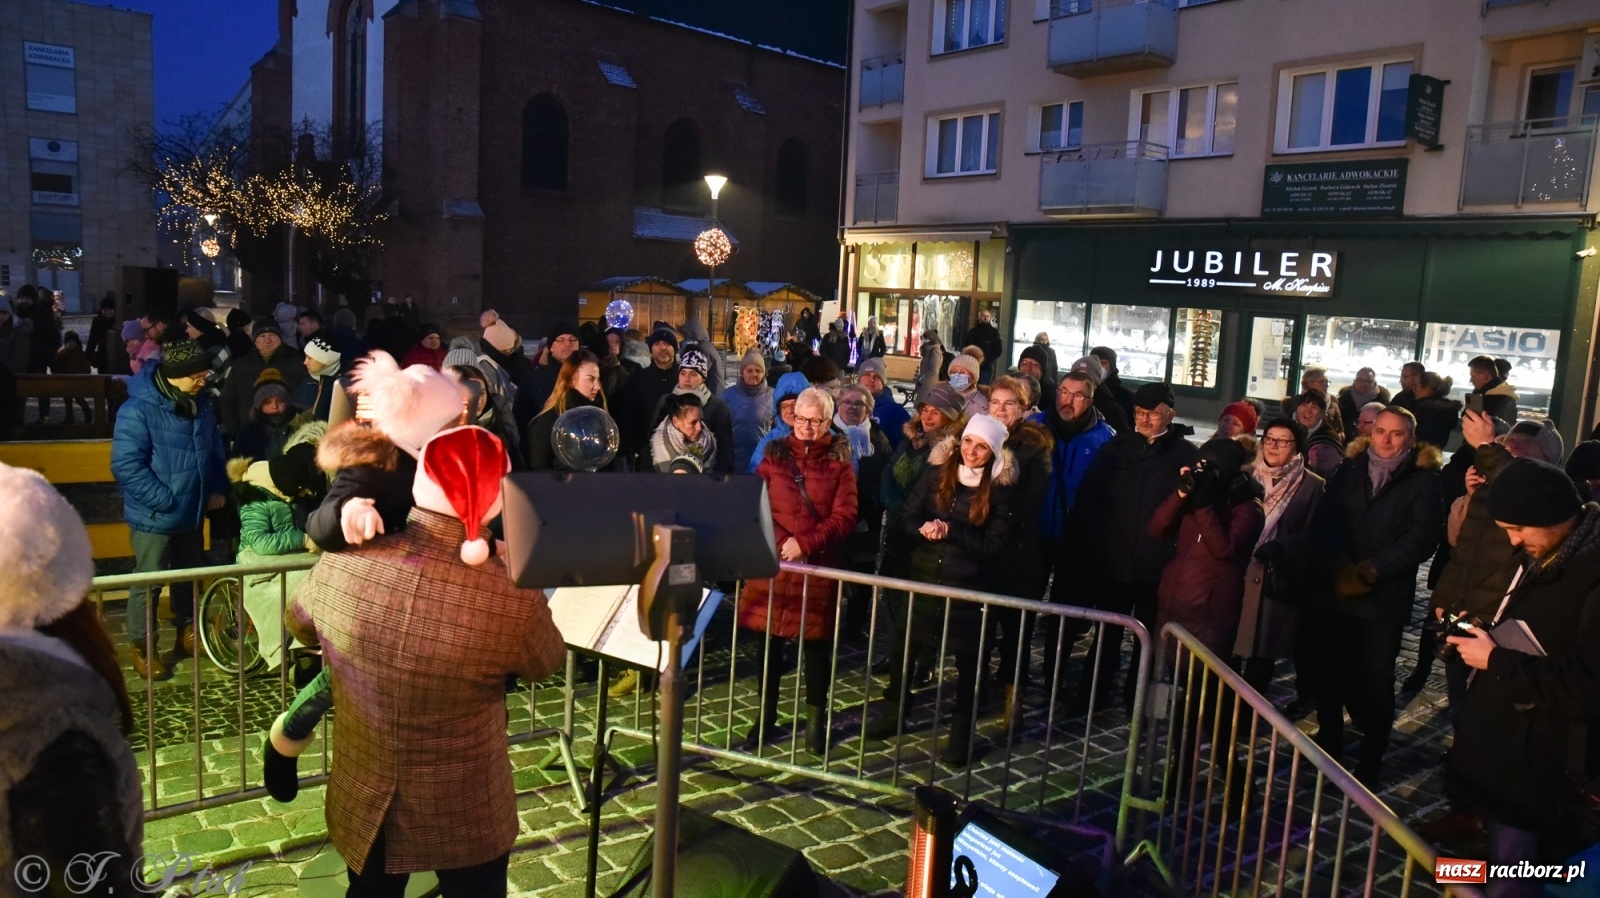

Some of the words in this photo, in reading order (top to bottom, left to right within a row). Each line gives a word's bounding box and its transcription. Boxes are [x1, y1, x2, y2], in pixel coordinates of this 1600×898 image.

[1286, 171, 1337, 182] KANCELARIE
[1339, 168, 1399, 179] ADWOKACKIE
[1150, 250, 1333, 277] JUBILER
[1186, 278, 1216, 288] 1989
